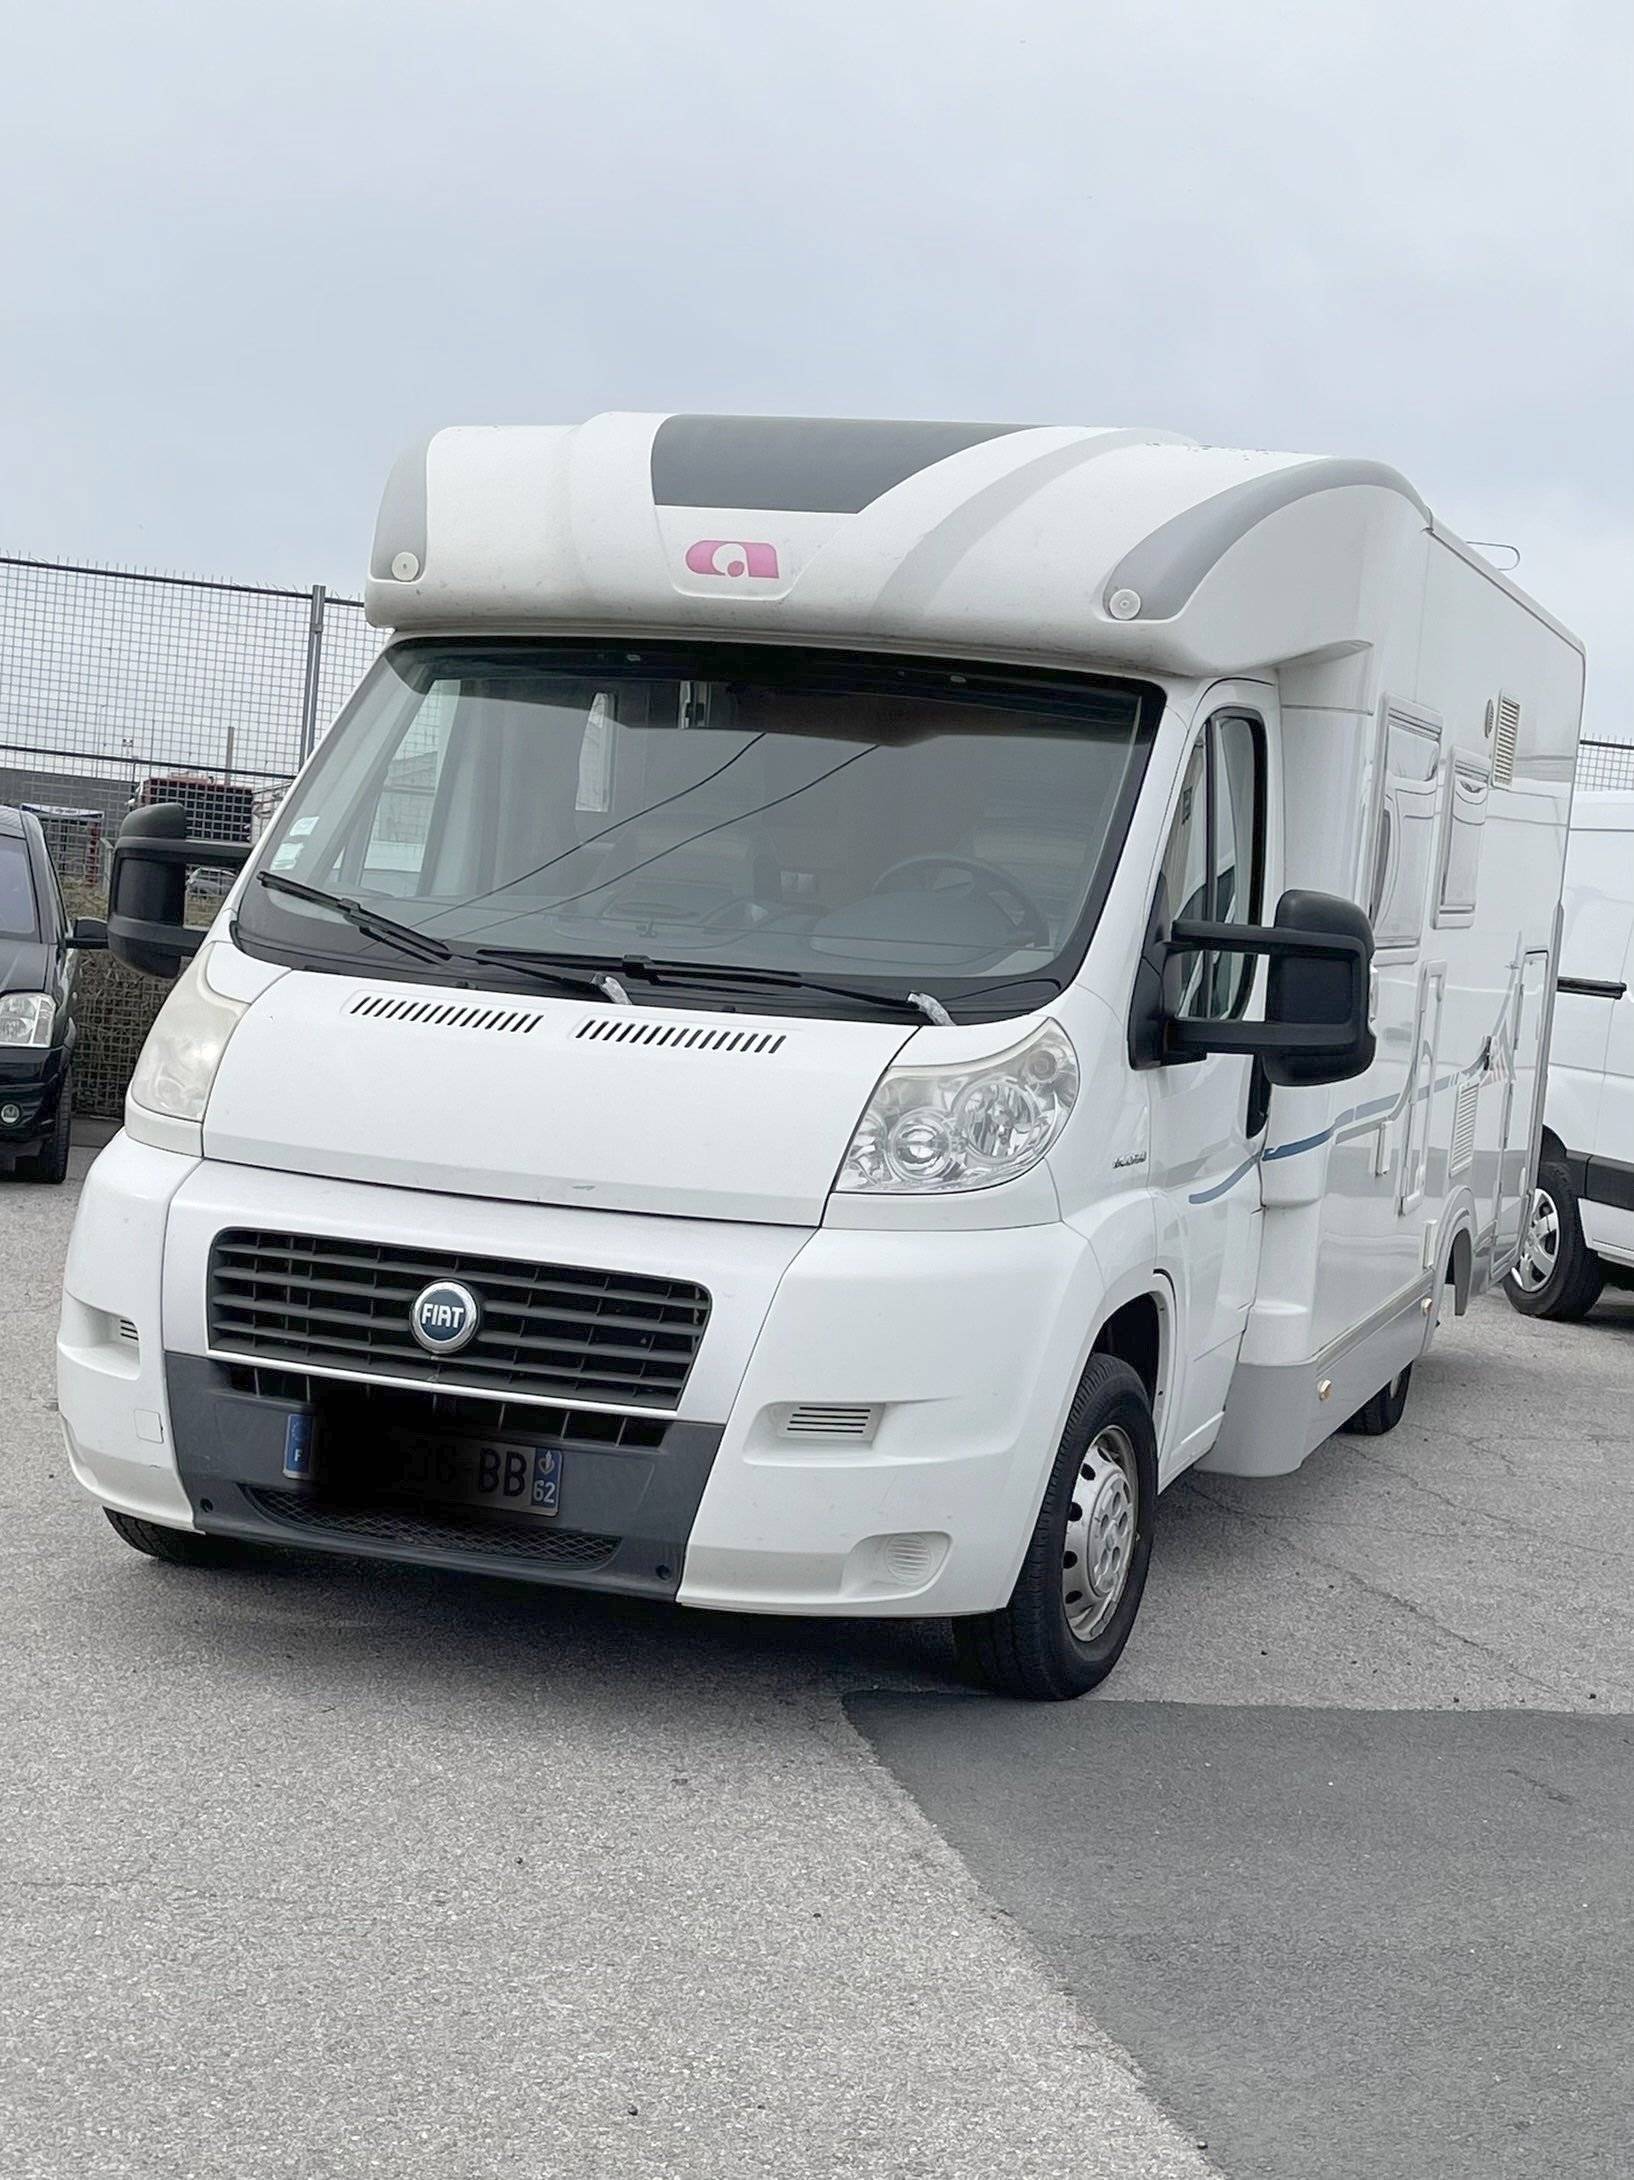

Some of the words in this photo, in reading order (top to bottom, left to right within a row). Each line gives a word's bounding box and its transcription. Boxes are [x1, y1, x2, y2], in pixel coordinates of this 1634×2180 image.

[421, 1303, 464, 1329] FIAT
[294, 1450, 302, 1462] F
[533, 1479, 556, 1504] 62
